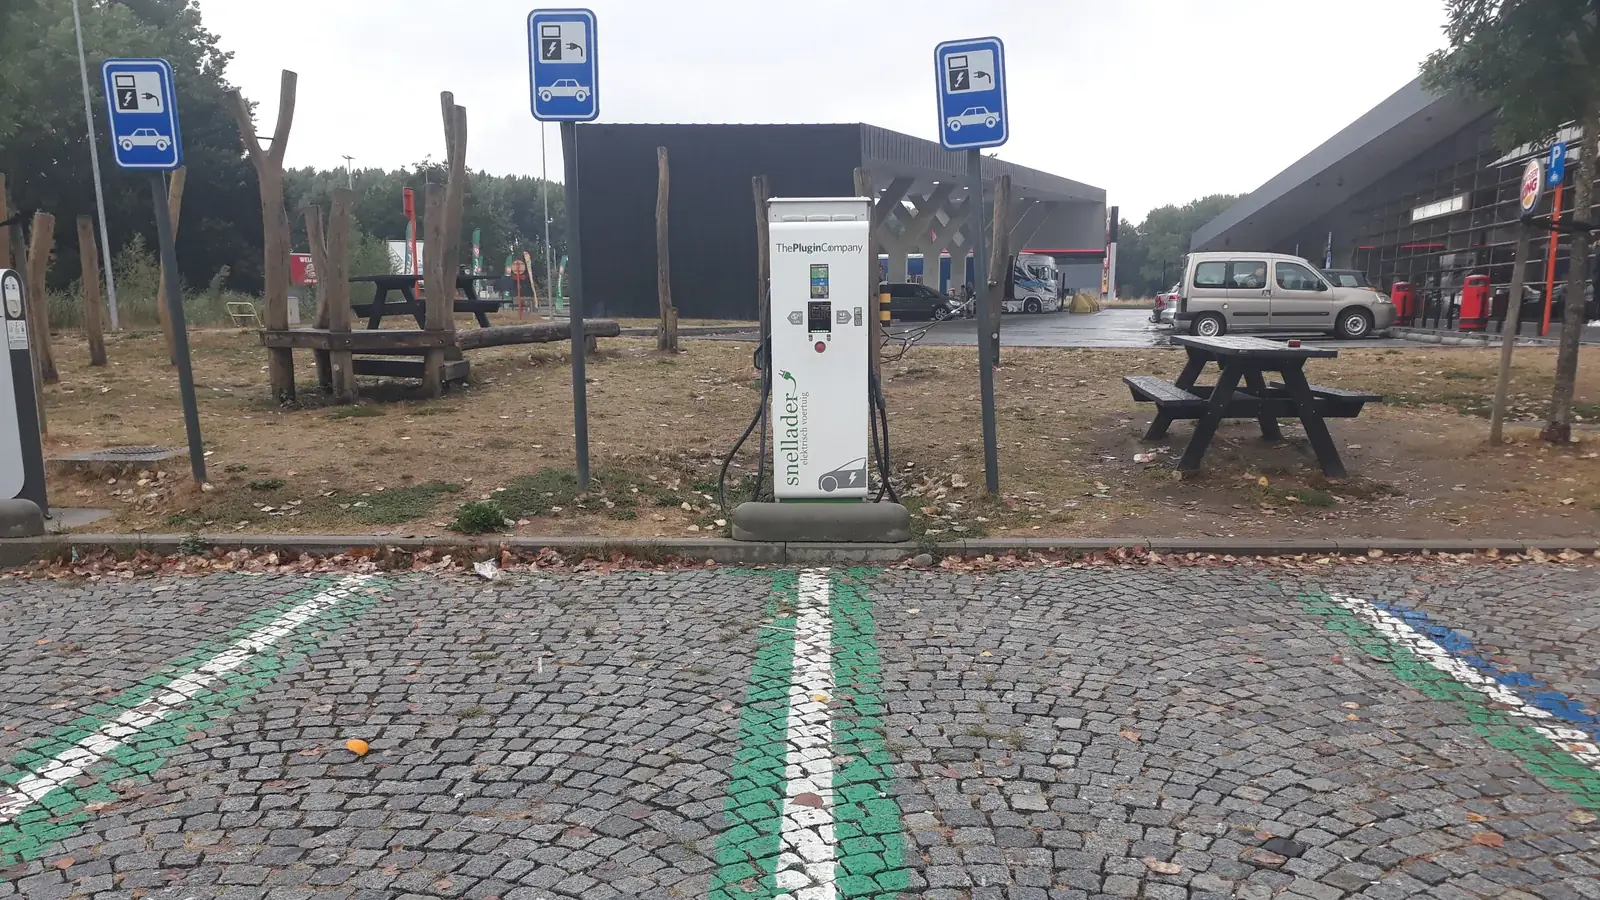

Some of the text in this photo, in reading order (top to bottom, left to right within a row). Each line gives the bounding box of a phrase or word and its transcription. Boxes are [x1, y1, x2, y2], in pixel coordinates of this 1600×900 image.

[1551, 145, 1561, 168] P
[776, 243, 863, 254] ThePluginCompany
[780, 393, 799, 486] snellader
[800, 391, 809, 466] elektrisch voertuig
